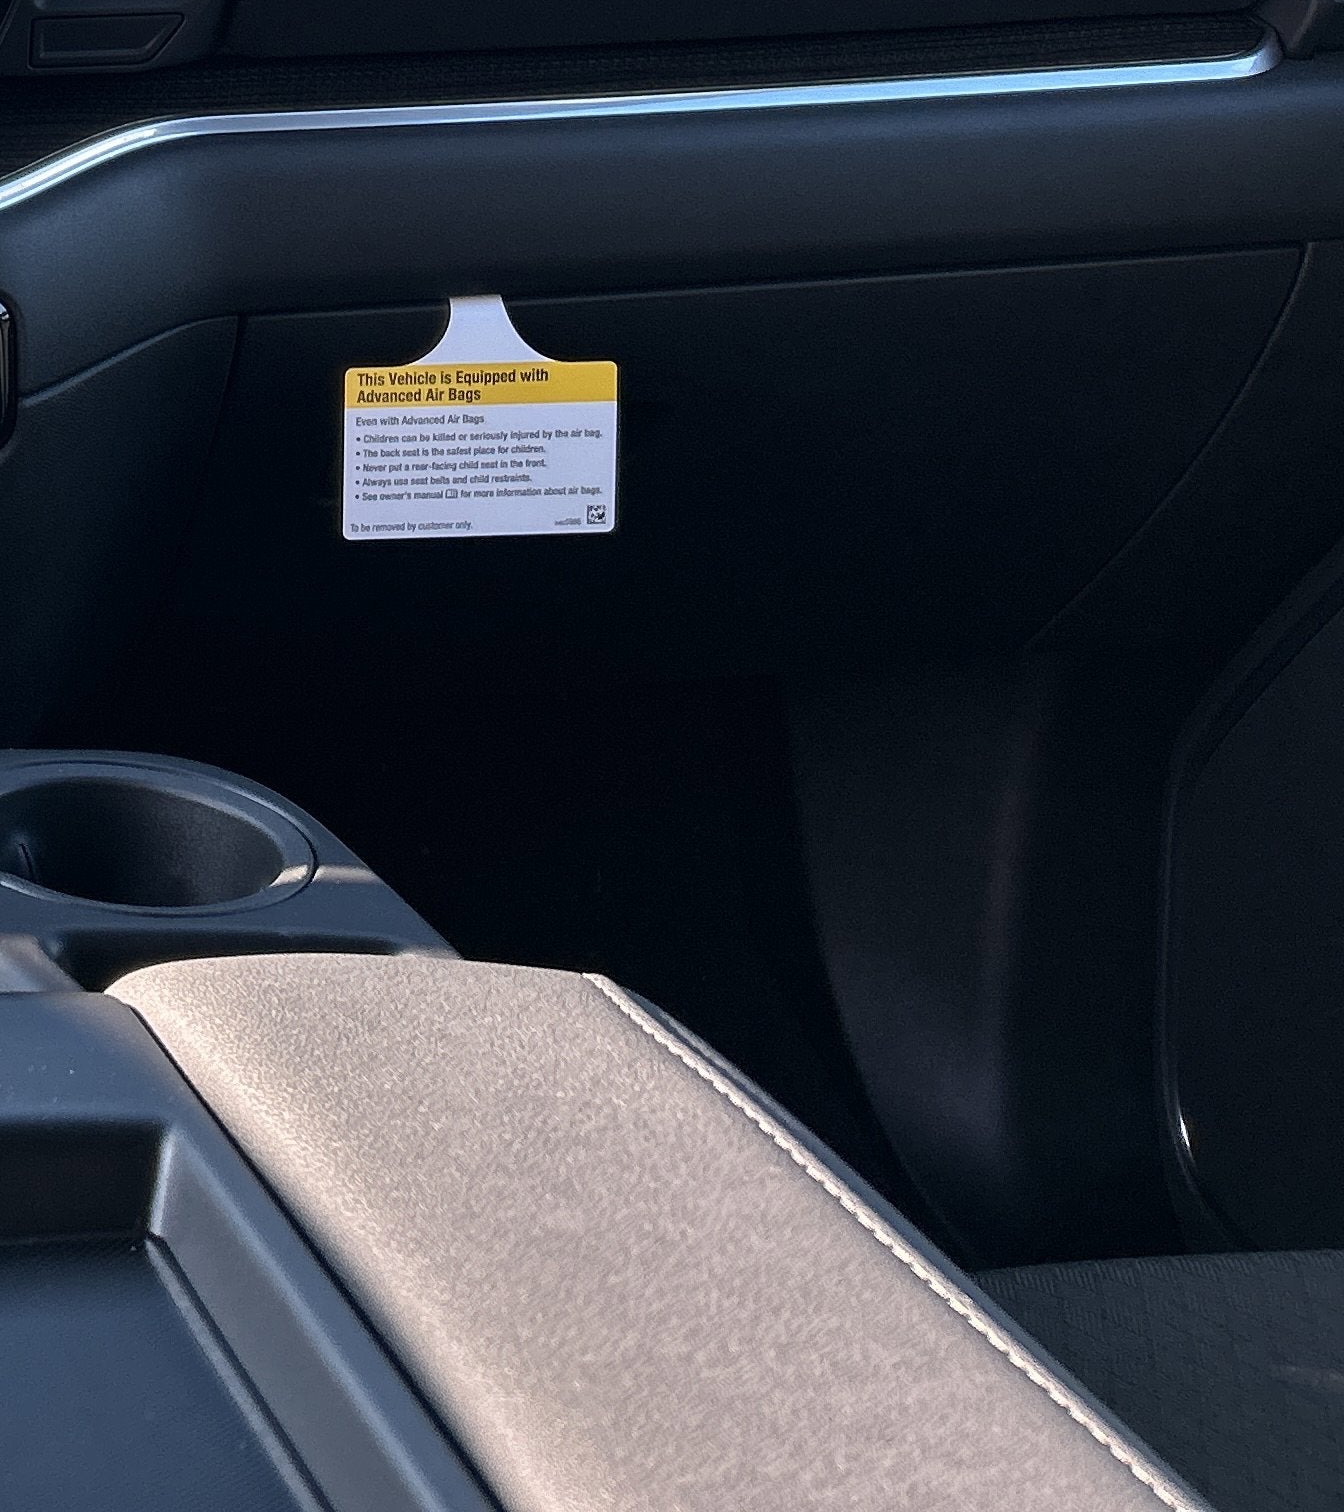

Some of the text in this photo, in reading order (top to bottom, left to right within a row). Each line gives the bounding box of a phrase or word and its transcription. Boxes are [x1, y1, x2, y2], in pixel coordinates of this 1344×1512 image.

[358, 368, 548, 386] This Vehicle is Equipped with
[356, 388, 481, 403] Advanced Air Bags
[356, 414, 484, 426] Even with Advanced Air Bags
[363, 434, 399, 443] Children
[402, 434, 417, 442] can
[420, 432, 430, 442] be
[433, 432, 456, 441] killed
[470, 430, 508, 441] seriously
[510, 429, 540, 439] injured
[542, 430, 552, 439] by
[555, 429, 568, 438] the
[571, 428, 582, 437] air
[584, 428, 602, 438] bag.
[363, 444, 545, 458] The back seat is the safest place for children.
[363, 463, 386, 472] Never
[388, 464, 402, 473] put
[412, 460, 457, 472] rear-facing
[459, 460, 478, 469] child
[481, 460, 498, 468] seat
[500, 460, 508, 468] in
[510, 458, 523, 467] the
[525, 458, 546, 467] front.
[362, 473, 532, 488] Always use seat belts and child restraints.
[362, 492, 377, 501] See
[380, 490, 411, 500] owner's
[414, 490, 443, 499] manual
[460, 490, 471, 498] for
[496, 487, 541, 496] information
[544, 486, 566, 495] about
[568, 486, 579, 494] air
[581, 486, 602, 496] bags.
[351, 520, 472, 532] To be removed by customer only.
